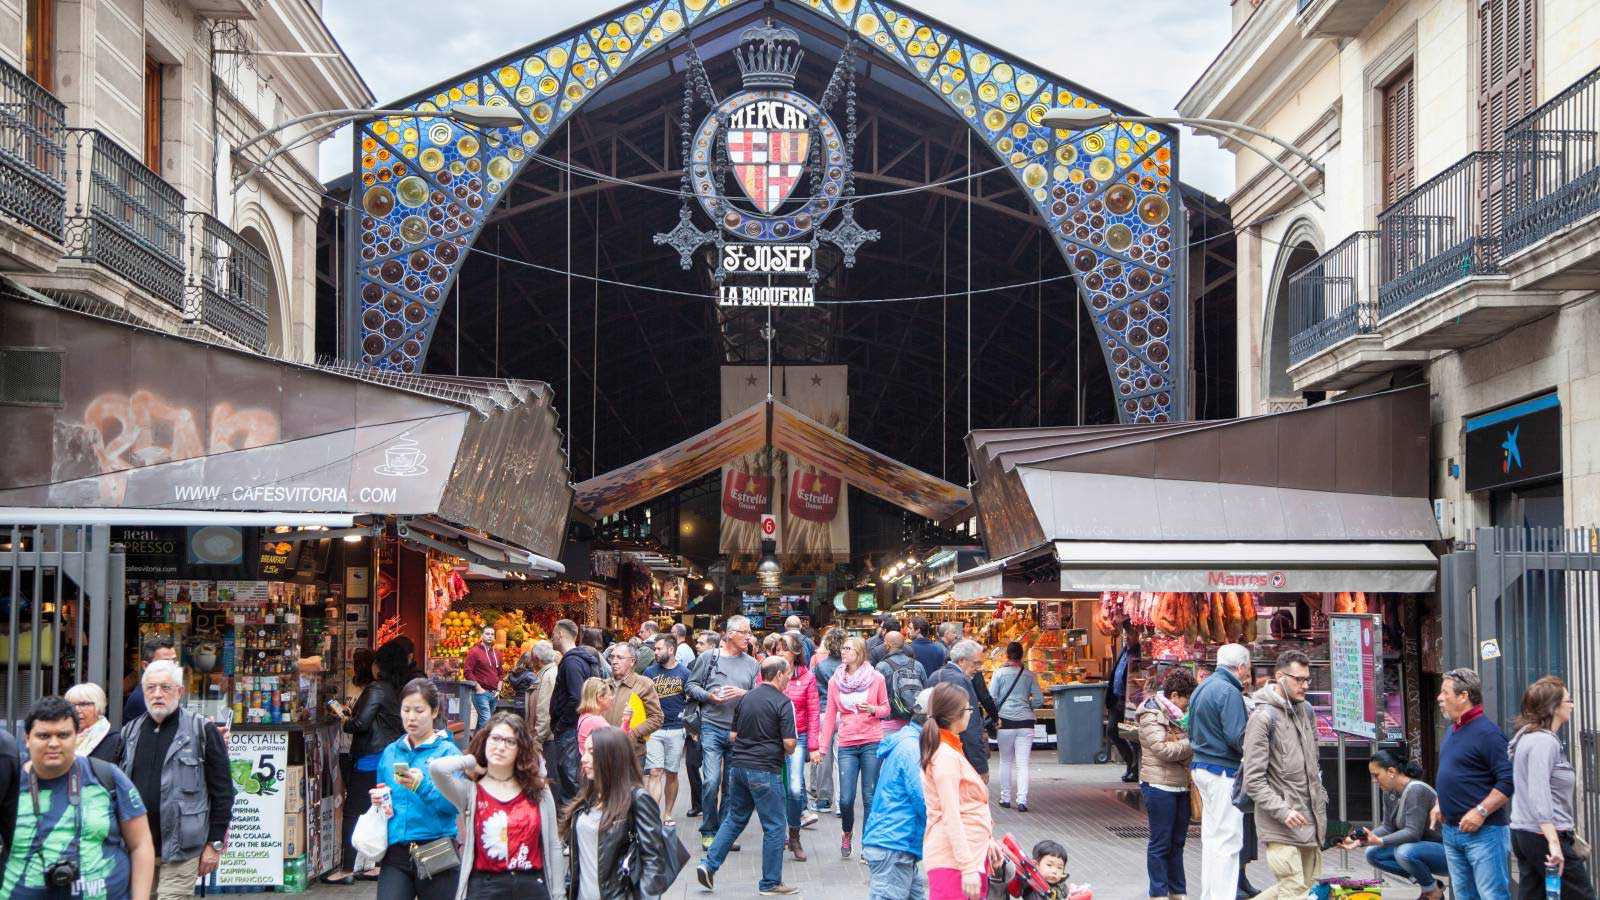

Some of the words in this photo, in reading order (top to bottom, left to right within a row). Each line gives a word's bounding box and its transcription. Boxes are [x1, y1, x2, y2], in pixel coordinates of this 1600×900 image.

[731, 101, 808, 129] MERCAT
[744, 245, 811, 271] JOSEP
[720, 287, 739, 306] LA
[742, 287, 815, 306] BOQUERIA
[175, 486, 222, 501] WWW
[232, 486, 347, 503] CAFESVITORIA
[360, 487, 397, 503] COM
[731, 488, 767, 505] Estrella
[797, 488, 834, 504] Estrella
[765, 520, 773, 533] 6
[1207, 571, 1268, 586] Marcos
[229, 733, 286, 745] OCKTAILS
